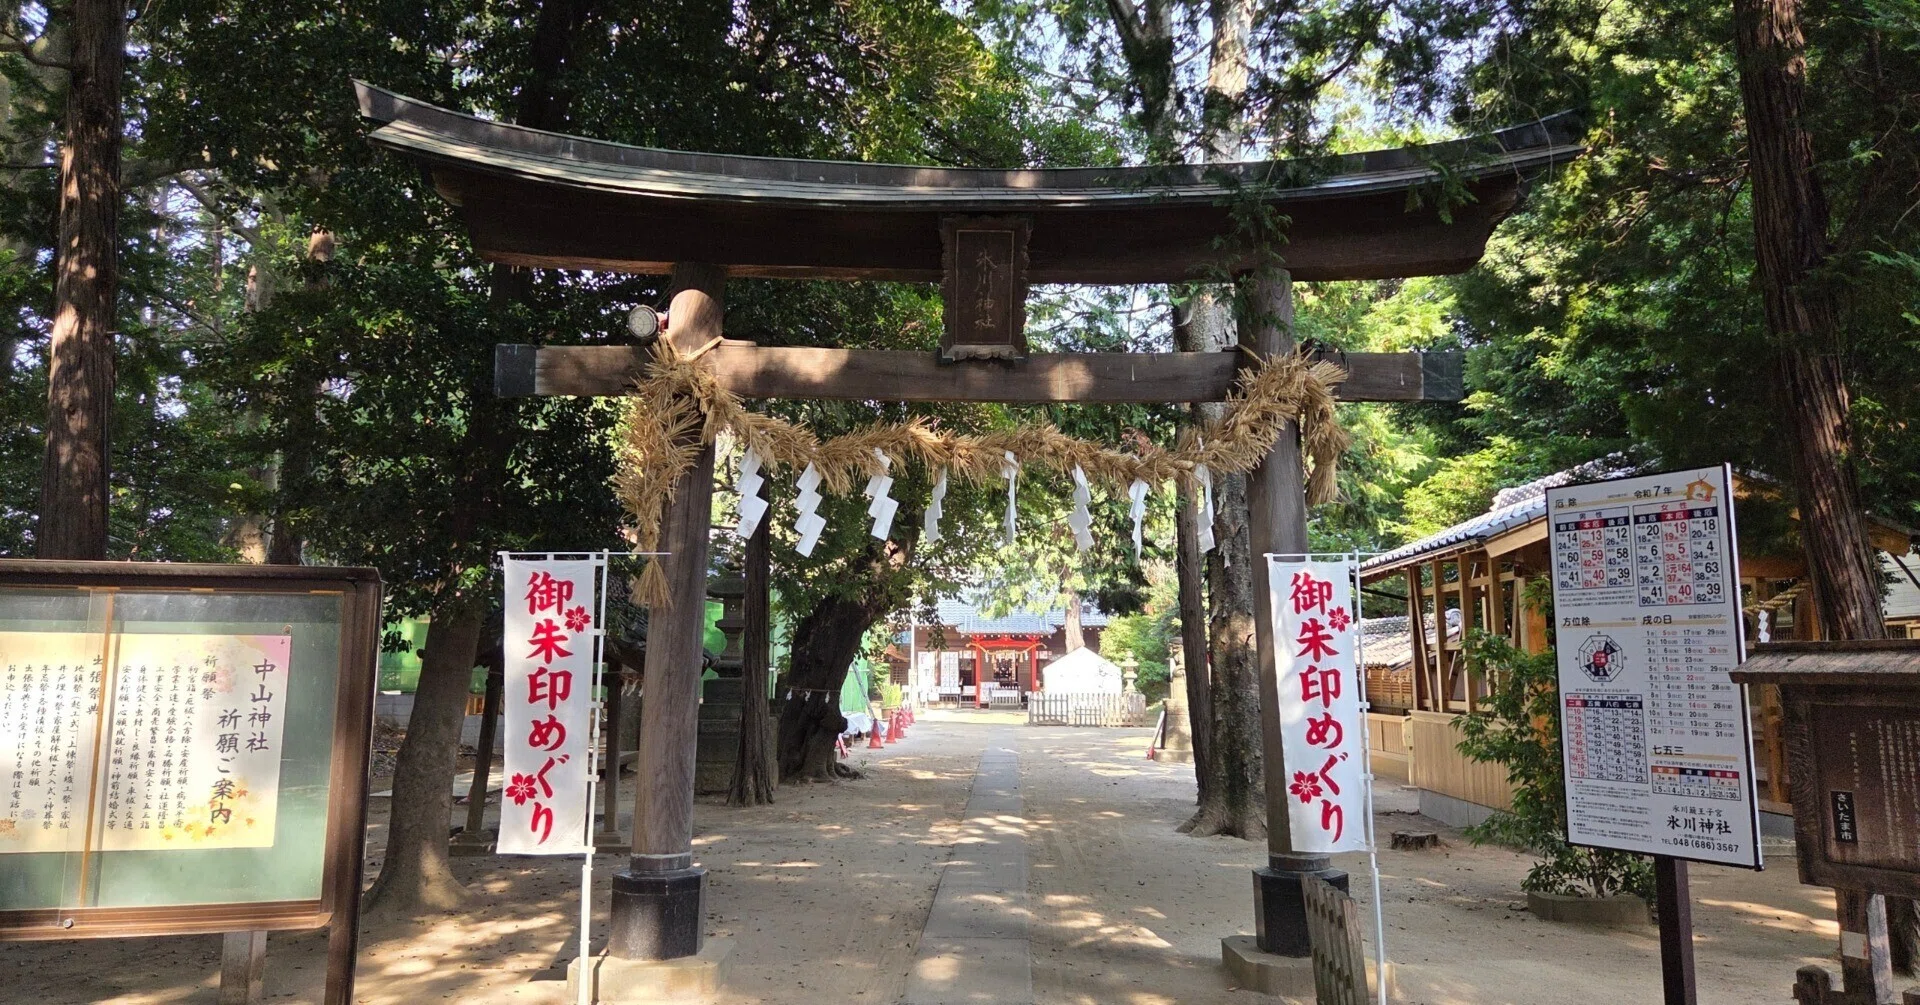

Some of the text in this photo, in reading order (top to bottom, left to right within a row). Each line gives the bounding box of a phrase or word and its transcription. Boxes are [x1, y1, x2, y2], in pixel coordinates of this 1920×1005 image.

[1555, 498, 1577, 508] 厄除
[1634, 486, 1672, 498] 令和7年
[1661, 502, 1687, 511] 女性
[1563, 617, 1590, 626] 方位除
[1642, 615, 1672, 625] 戌の日
[86, 654, 103, 715] 出張祭典
[202, 655, 218, 699] 祈願祭
[245, 659, 276, 753] 中山神社
[524, 571, 573, 845] 御朱印めぐり
[1289, 572, 1348, 844] 御朱印めぐり
[211, 708, 242, 824] 祈願ご案内
[1653, 745, 1684, 756] 七五三
[1667, 815, 1732, 835] 氷川神社
[1837, 793, 1853, 840] さいたま市
